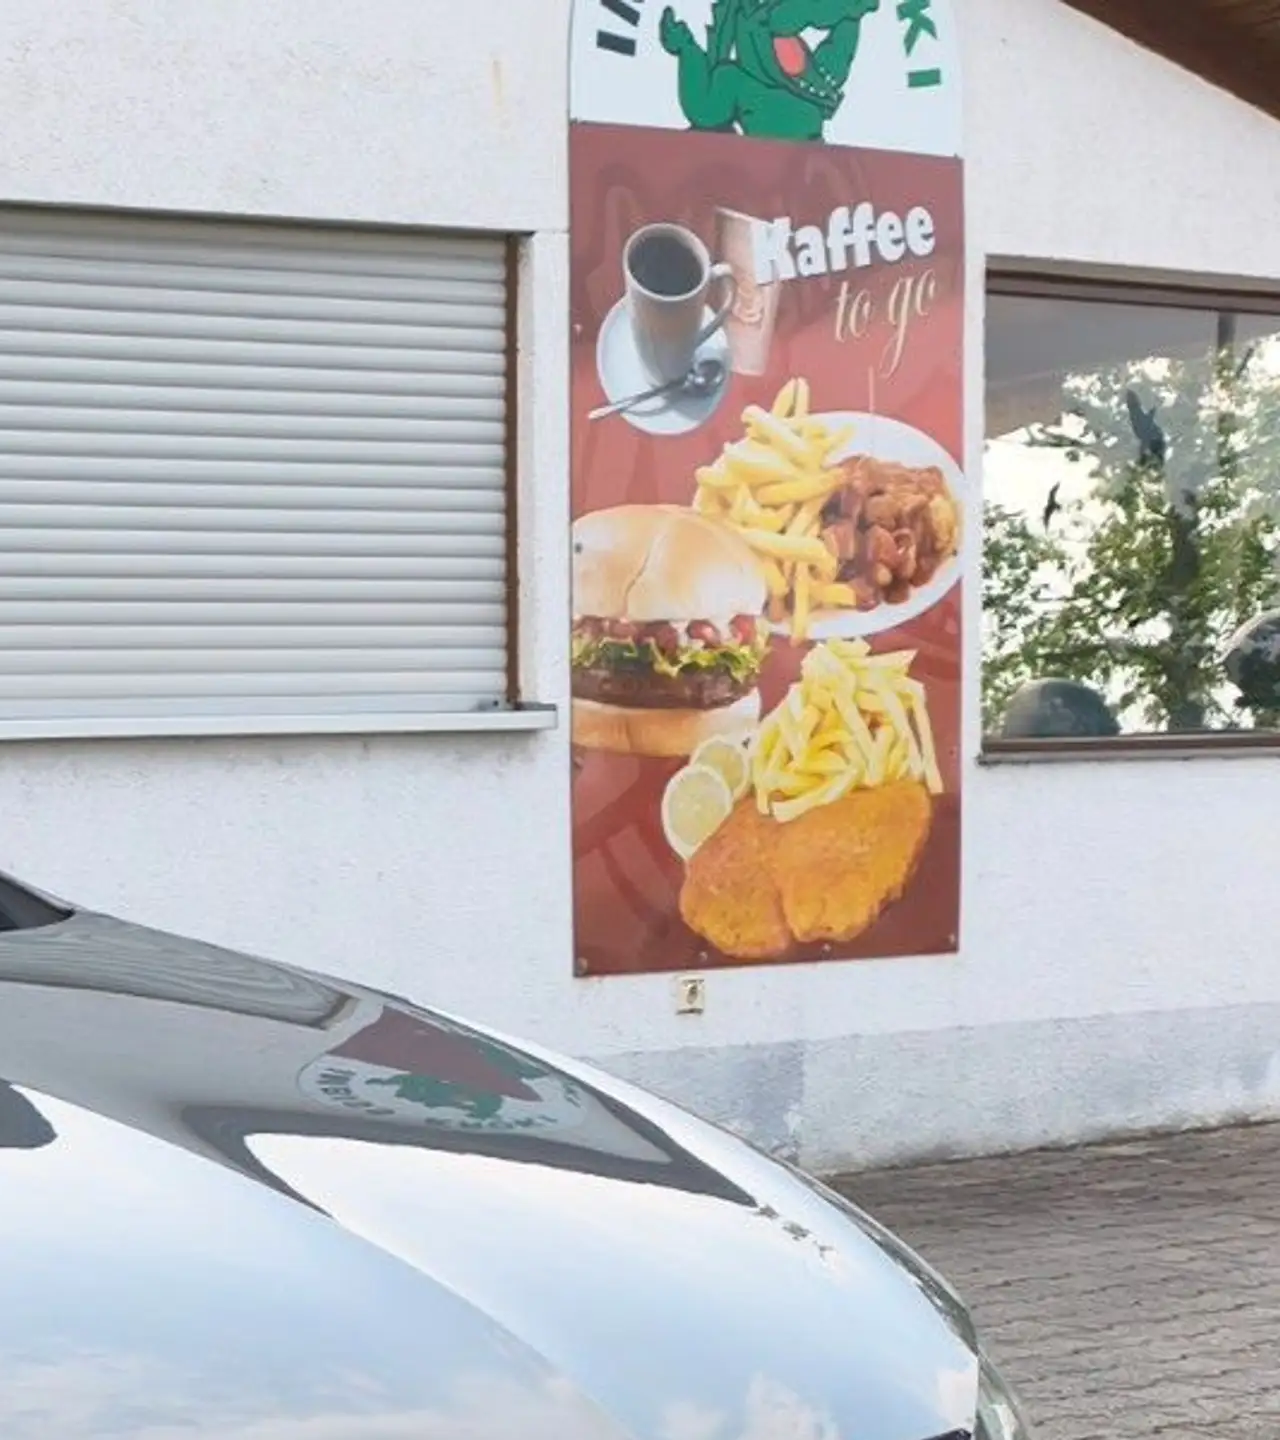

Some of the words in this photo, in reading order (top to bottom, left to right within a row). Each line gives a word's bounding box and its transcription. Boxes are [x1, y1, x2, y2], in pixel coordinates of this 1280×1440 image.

[753, 202, 936, 285] Kaffee
[835, 280, 872, 343] to
[879, 269, 936, 378] go
